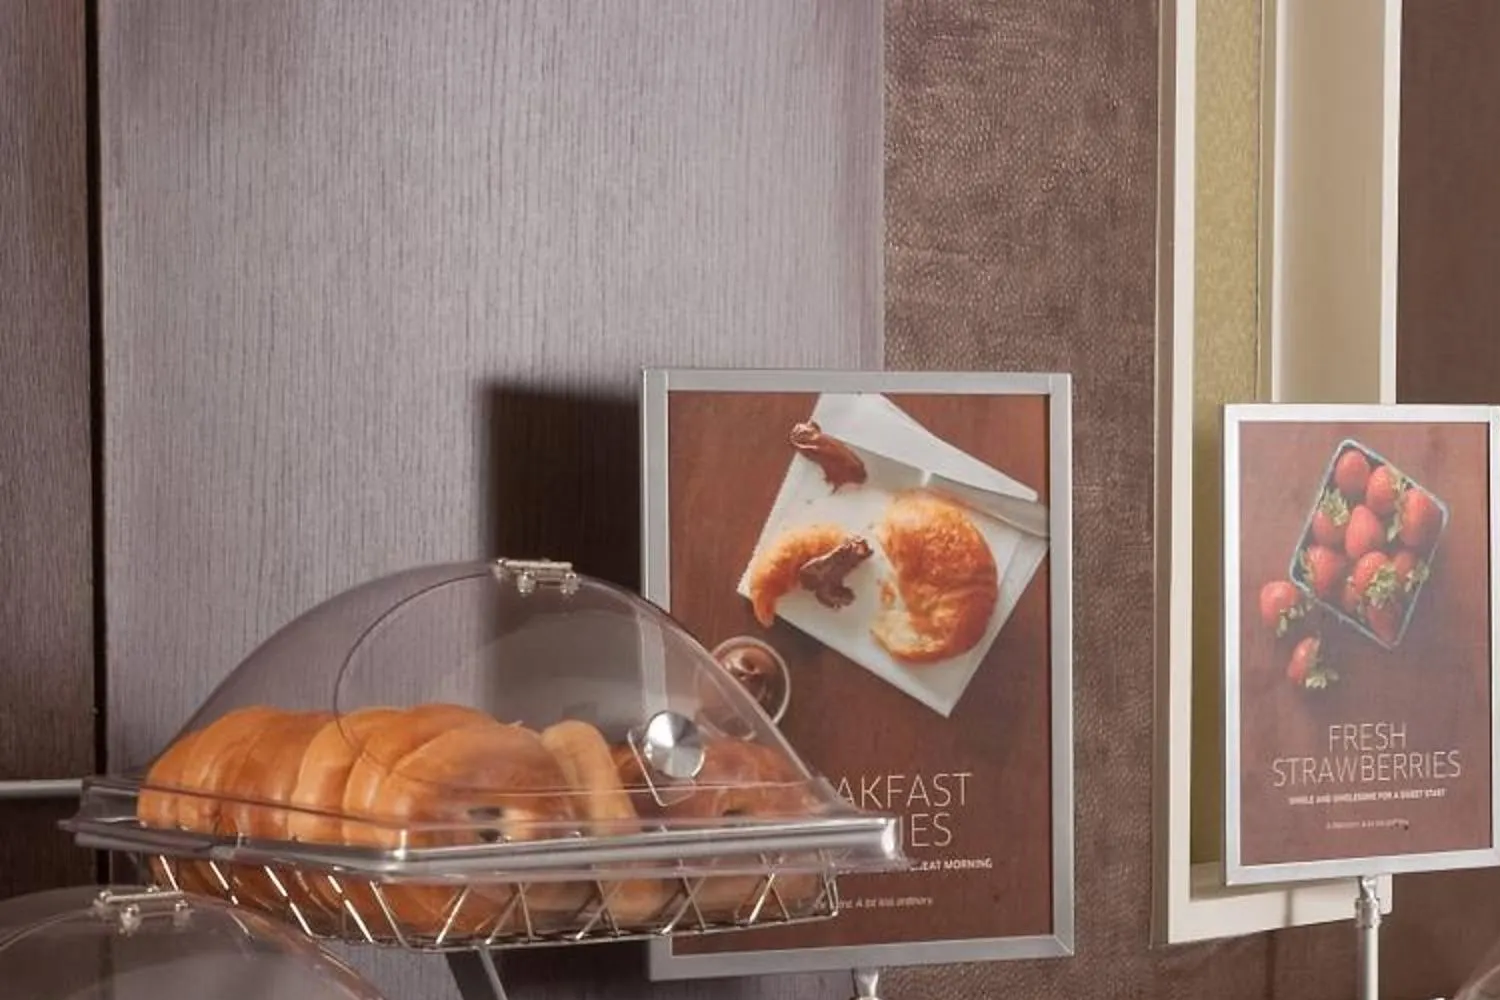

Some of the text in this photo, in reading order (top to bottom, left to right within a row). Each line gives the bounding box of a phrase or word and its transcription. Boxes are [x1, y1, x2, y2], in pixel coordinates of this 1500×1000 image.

[1328, 722, 1407, 752] FRESH
[1271, 750, 1462, 787] STRAWBERRIES
[836, 772, 973, 808] AKFAST
[943, 857, 993, 871] MORNING
